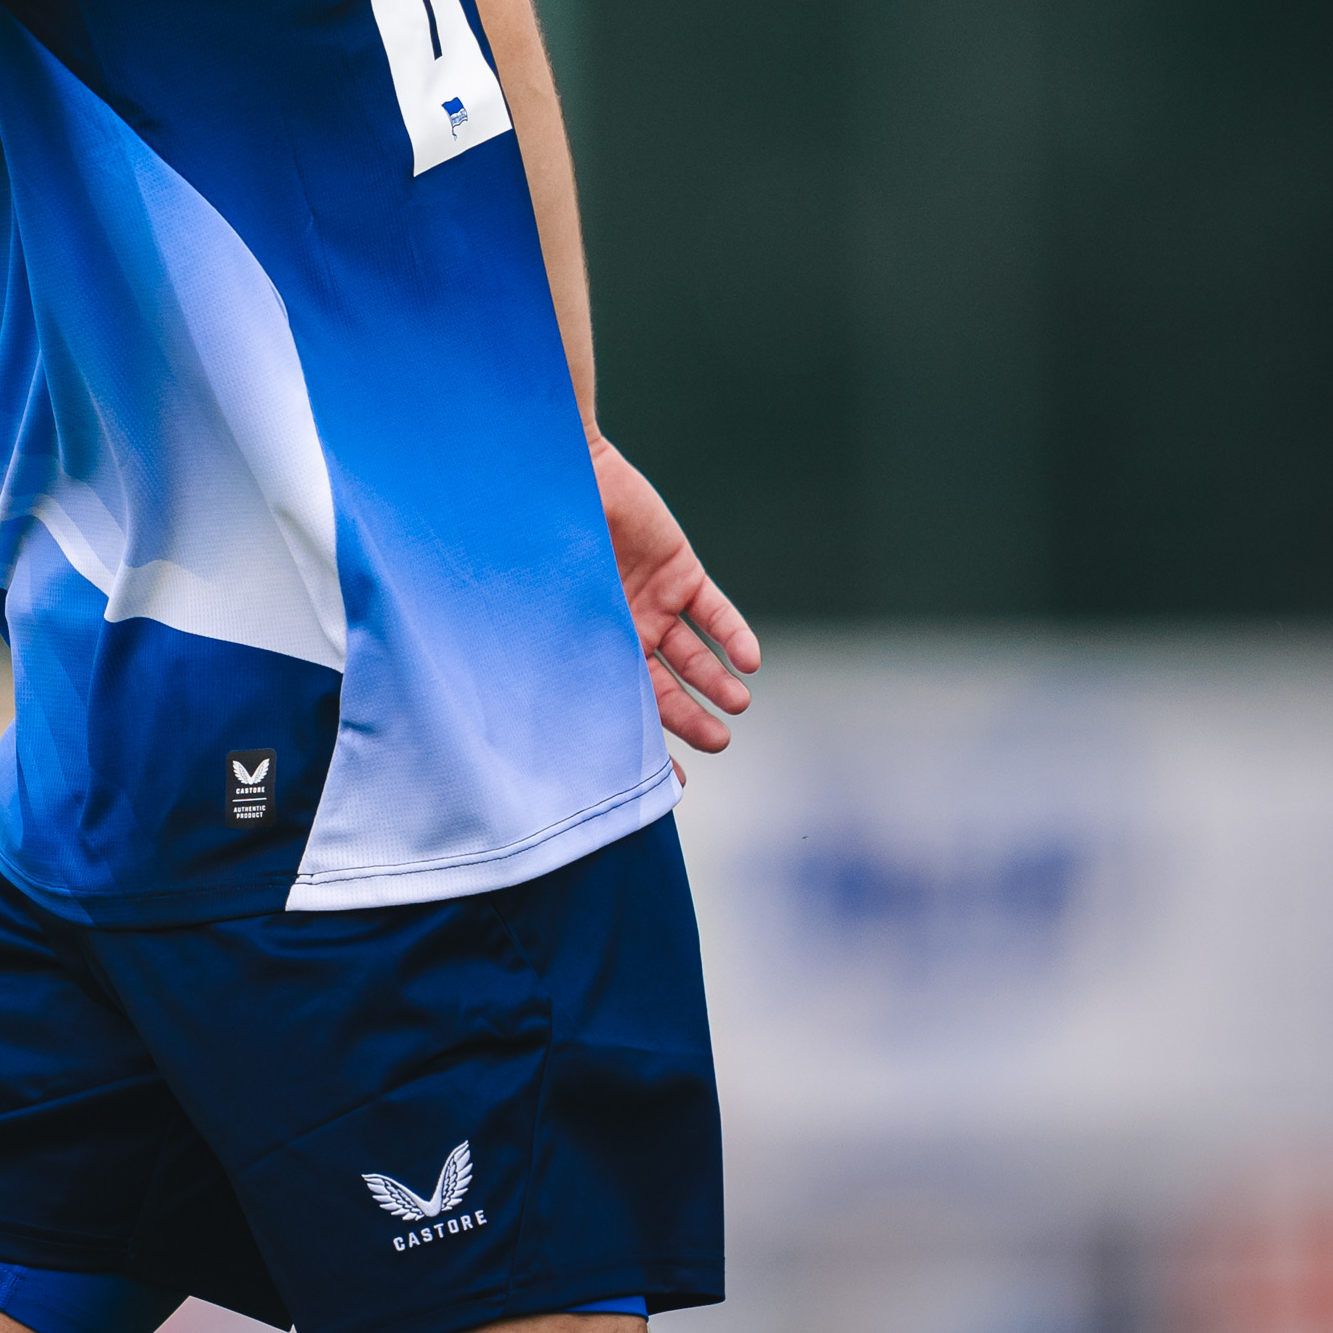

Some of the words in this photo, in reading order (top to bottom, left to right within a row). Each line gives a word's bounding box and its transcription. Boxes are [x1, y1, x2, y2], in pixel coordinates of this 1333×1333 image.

[235, 786, 266, 795] CASTORE
[233, 805, 267, 813] AUTHENTIC
[393, 1209, 488, 1251] CASTORE
